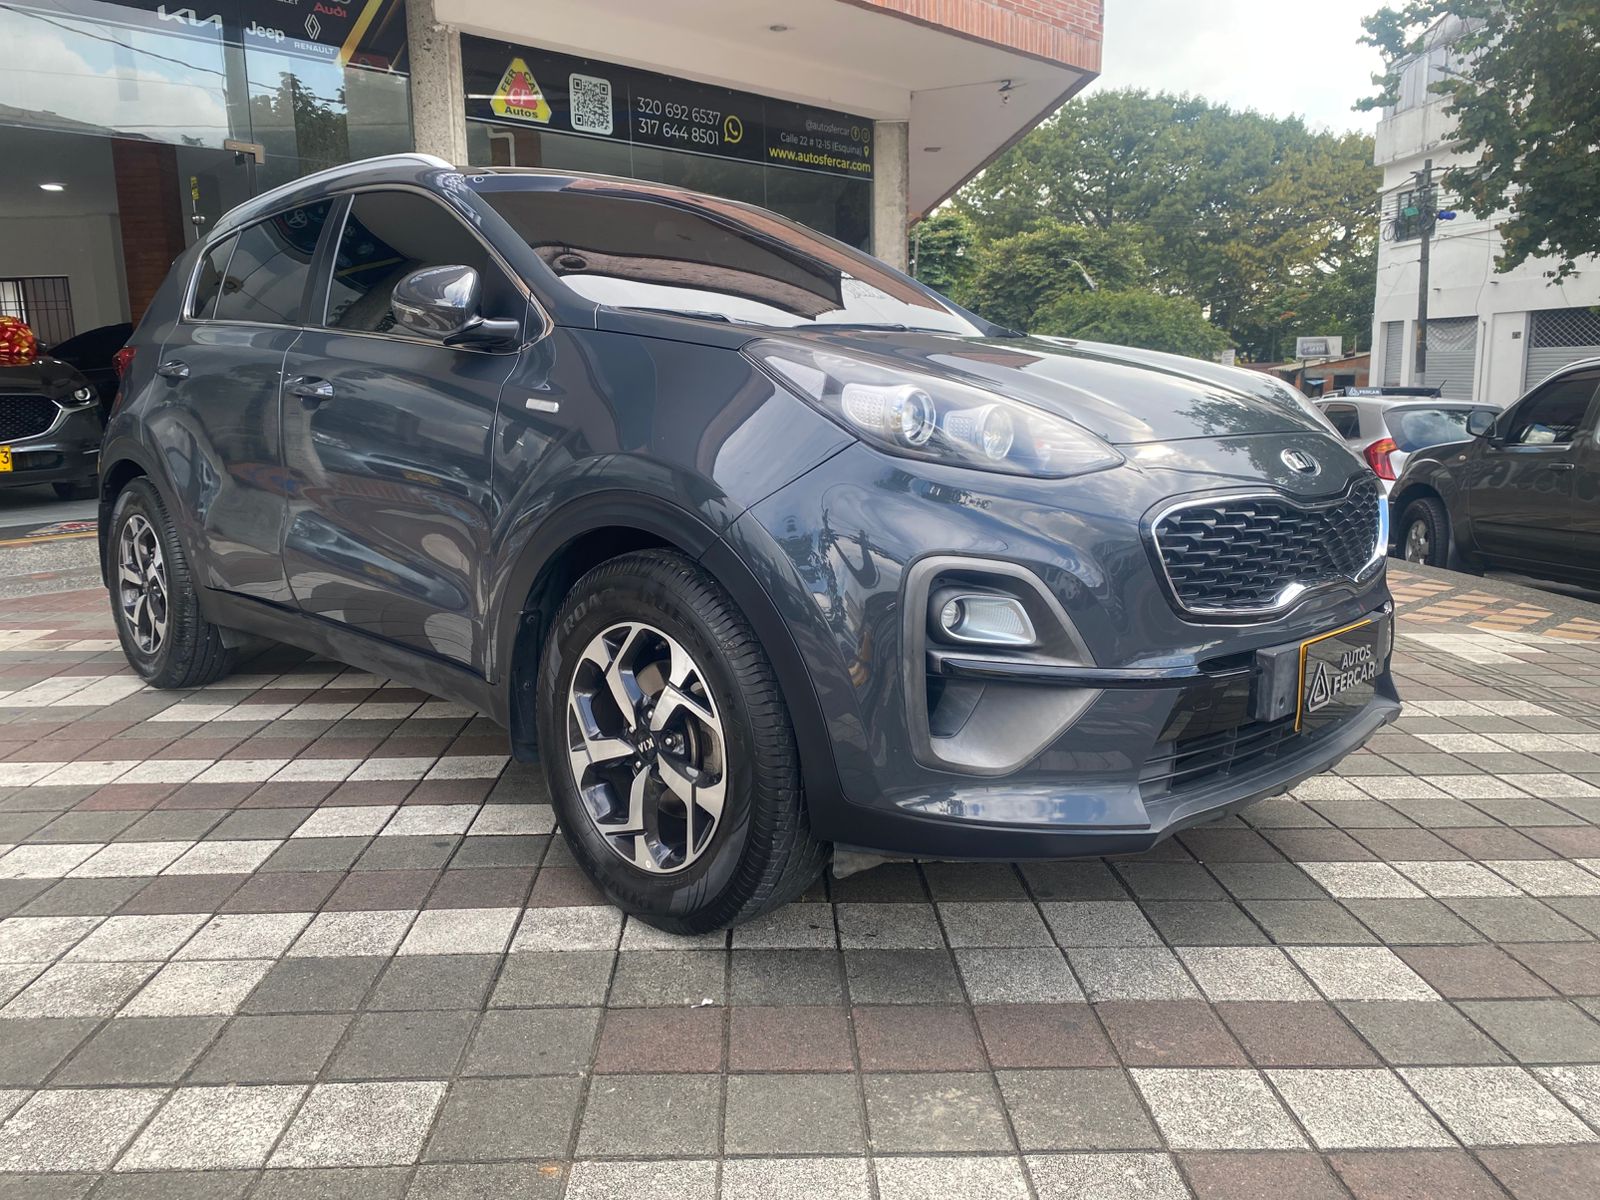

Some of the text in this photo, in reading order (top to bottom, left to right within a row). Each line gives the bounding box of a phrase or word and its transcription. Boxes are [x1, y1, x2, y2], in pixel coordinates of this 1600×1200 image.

[314, 2, 347, 17] Audi
[246, 20, 285, 43] Jeep
[294, 41, 334, 55] RENAULT
[501, 69, 517, 93] FER
[504, 106, 538, 118] Autos
[637, 96, 720, 126] 320 692 6537
[638, 118, 719, 145] 317 644 8501
[780, 132, 798, 145] Calle
[799, 135, 808, 146] 22
[769, 147, 871, 173] www.autosfercar.com
[1341, 644, 1371, 670] AUTOS
[1332, 661, 1376, 695] FERCAR
